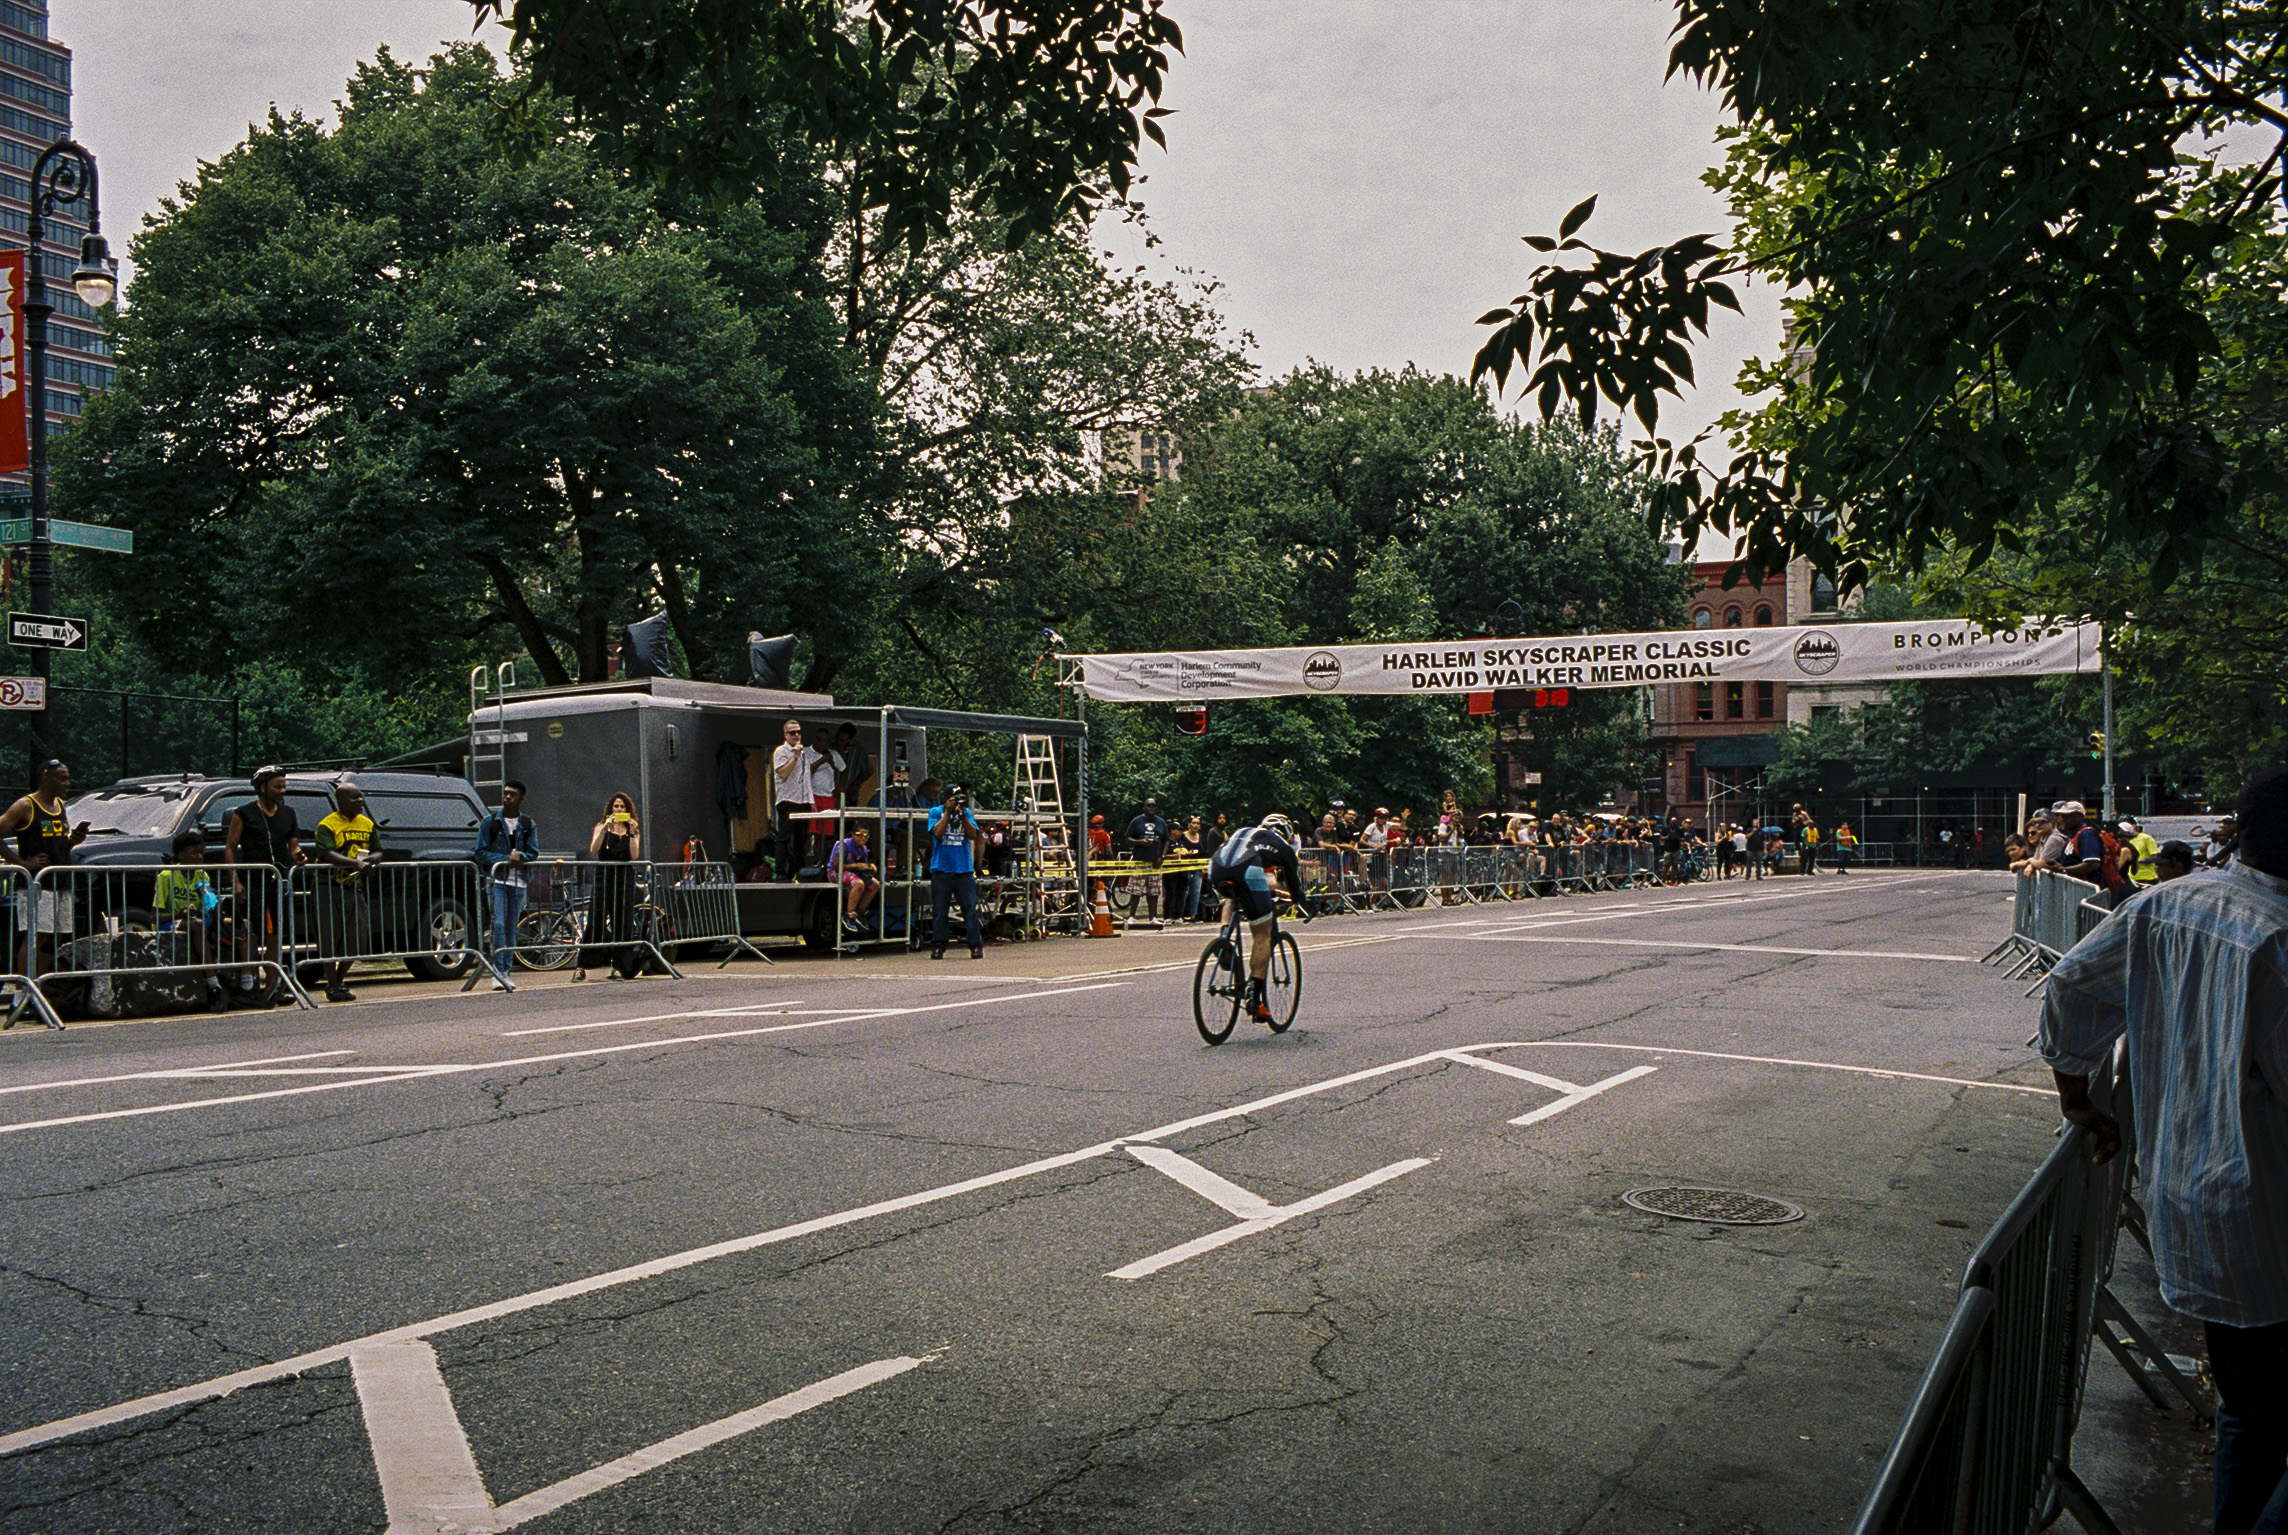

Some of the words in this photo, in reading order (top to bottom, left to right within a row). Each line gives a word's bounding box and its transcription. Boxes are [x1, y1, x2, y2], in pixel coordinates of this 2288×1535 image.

[1, 524, 16, 541] 121
[21, 522, 29, 531] ST
[19, 623, 43, 637] ONE
[52, 626, 75, 641] WAY
[1382, 651, 1476, 670] HARLEM
[1483, 644, 1638, 667] SKYSCRAPER
[1645, 639, 1751, 660] CLASSIC
[1181, 662, 1211, 670] Harlem
[1213, 660, 1261, 672] Community
[1895, 663, 1937, 672] WORLD
[1940, 658, 2041, 671] CHAMPIONSHIPS
[1181, 671, 1236, 680] Development
[1411, 671, 1480, 689] DAVID
[1485, 666, 1584, 686] WALKER
[1590, 662, 1721, 683] MEMORIAL
[1181, 680, 1232, 690] Corporation
